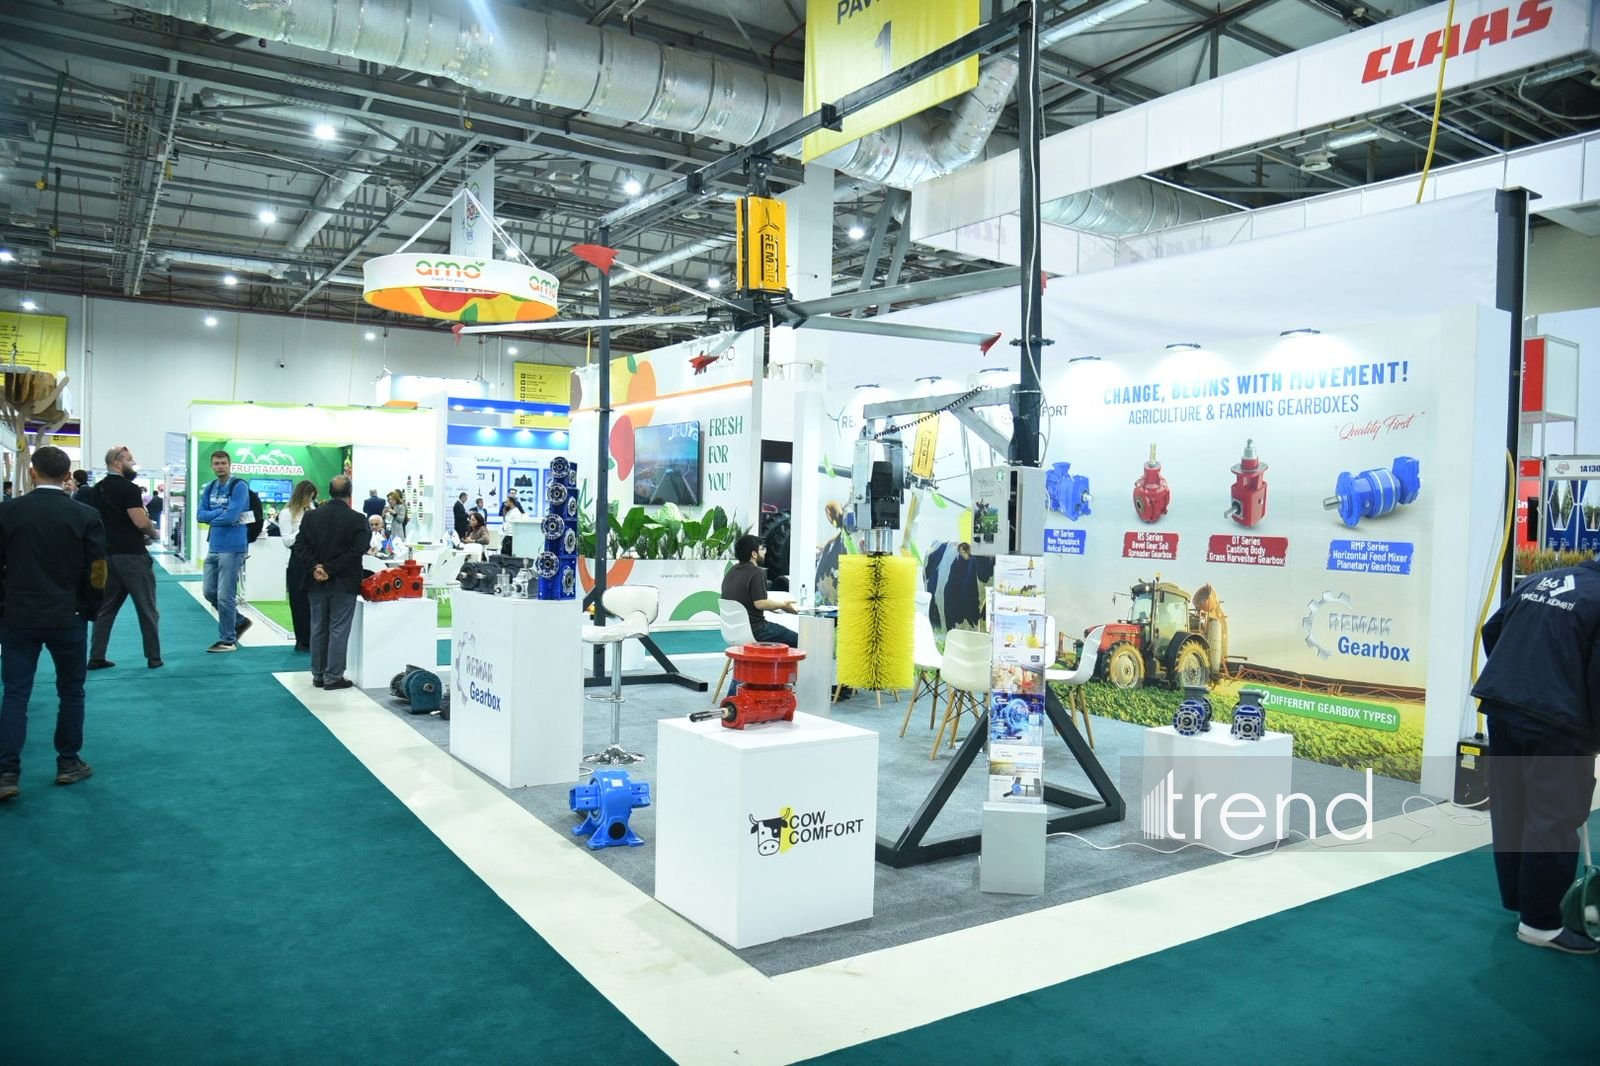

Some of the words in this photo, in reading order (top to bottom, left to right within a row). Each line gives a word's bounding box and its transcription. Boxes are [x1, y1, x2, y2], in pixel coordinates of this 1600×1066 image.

[875, 20, 892, 76] 1
[1361, 0, 1554, 84] CLAAS
[764, 233, 774, 283] REMAIR
[415, 260, 482, 279] amo
[1104, 383, 1166, 405] CHANGE,
[1171, 377, 1230, 399] BEGINS
[1236, 372, 1282, 395] WITH
[1290, 361, 1409, 391] MOVEMENT!
[1128, 405, 1202, 425] AGRICULTURE
[1206, 404, 1215, 421] &
[1219, 400, 1274, 420] FARMING
[1278, 394, 1360, 417] GEARBOXES
[709, 416, 743, 437] FRESH
[708, 445, 729, 464] FOR
[231, 463, 304, 475] FRUTTAMANIA
[708, 472, 732, 491] YOU!
[1131, 541, 1145, 549] Bevel
[1146, 542, 1158, 550] Gear
[1137, 532, 1145, 540] RS
[1146, 533, 1163, 541] Series
[1241, 536, 1261, 546] Series
[1151, 550, 1172, 559] Gearbox
[1226, 544, 1249, 555] Casting
[1250, 545, 1265, 556] Body
[1333, 550, 1367, 560] Horizontal
[1369, 552, 1386, 561] Feed
[1388, 553, 1408, 562] Mixer
[1350, 541, 1365, 550] RMP
[1367, 542, 1389, 552] Series
[1209, 552, 1226, 561] Grass
[1226, 553, 1256, 563] Harvester
[1257, 555, 1284, 565] Gearbox
[1336, 560, 1370, 572] Planetary
[1371, 562, 1400, 572] Gearbox
[1538, 577, 1560, 588] 166
[1329, 612, 1393, 636] REMAK
[1338, 636, 1411, 662] Gearbox
[466, 655, 494, 684] REMAK
[470, 681, 501, 712] Gearbox
[1271, 694, 1316, 712] DIFFERENT
[1317, 702, 1360, 720] GEARBOX
[1362, 710, 1397, 725] TYPES!
[789, 810, 826, 829] COW
[789, 818, 864, 845] COMFORT
